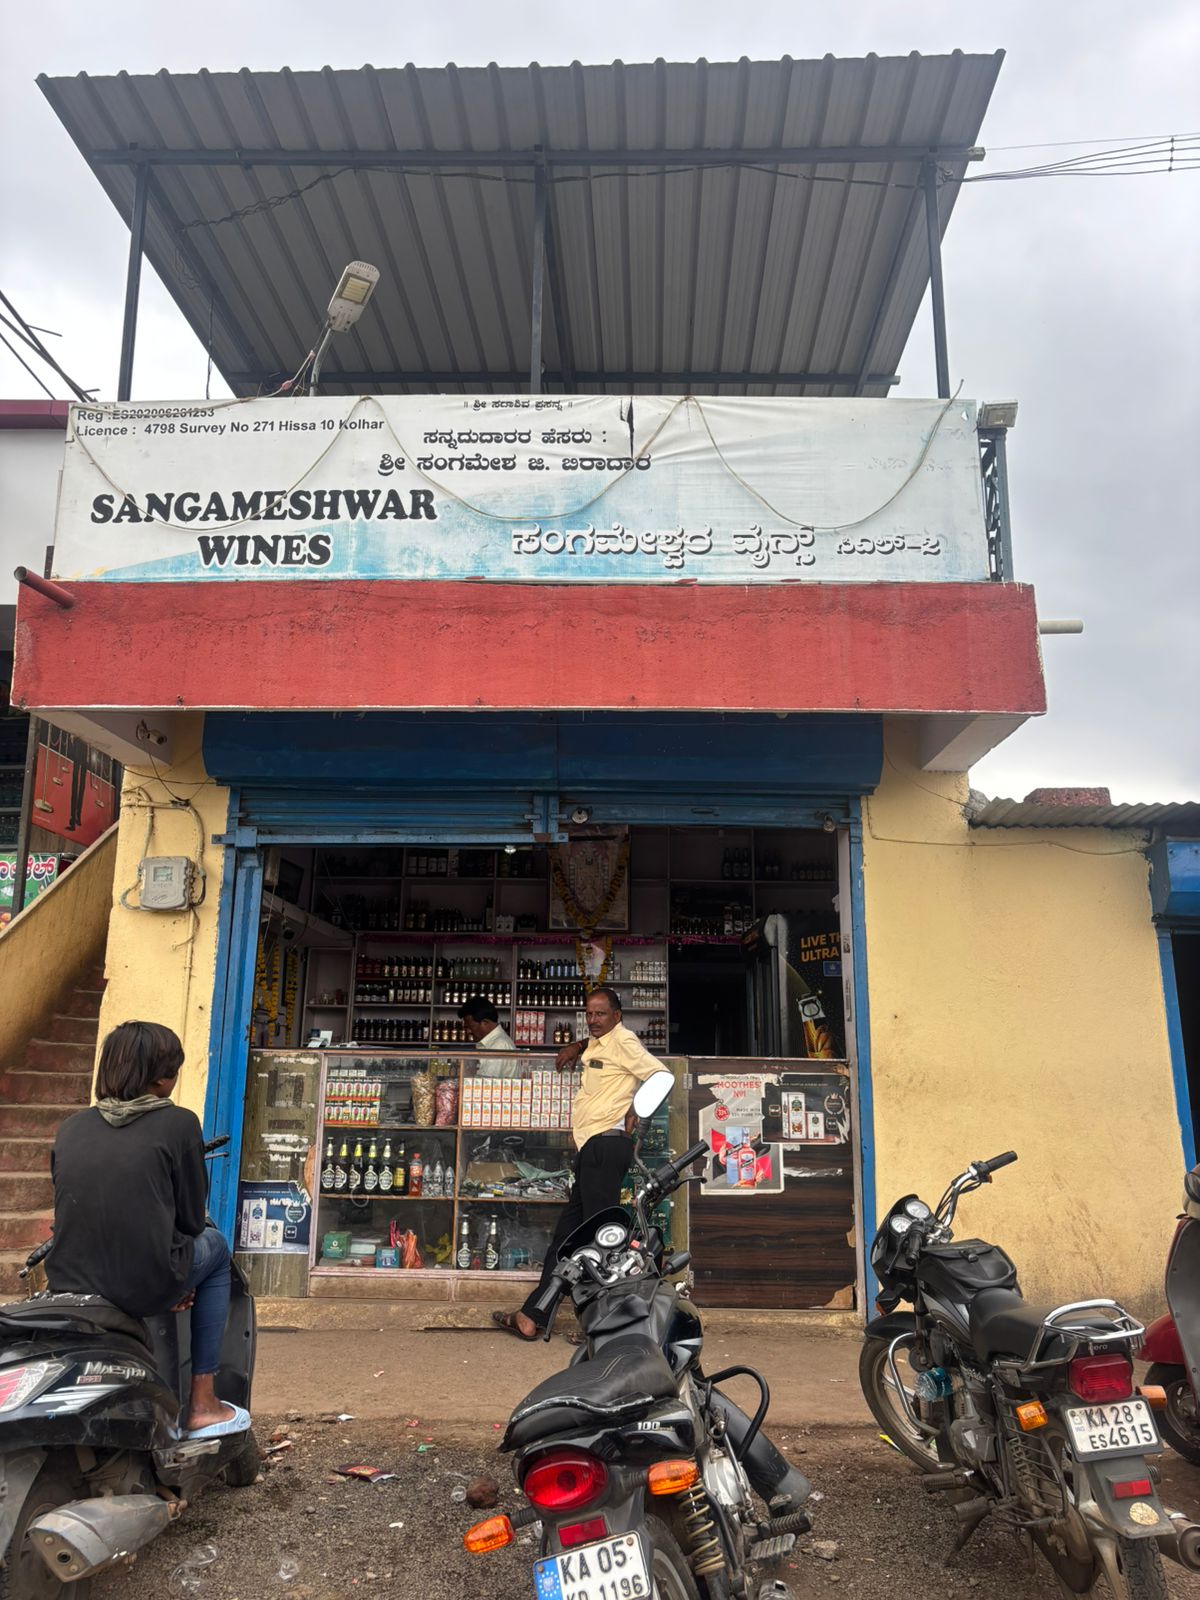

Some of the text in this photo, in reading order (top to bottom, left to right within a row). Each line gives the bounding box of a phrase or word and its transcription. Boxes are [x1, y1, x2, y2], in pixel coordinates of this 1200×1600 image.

[76, 425, 128, 437] Licence
[144, 424, 176, 435] 4798
[179, 422, 226, 437] Survey
[230, 422, 249, 433] No
[253, 421, 275, 432] 271
[279, 420, 317, 432] Hissa
[320, 419, 335, 430] 10
[339, 418, 385, 431] Kolhar
[77, 410, 103, 423] Reg
[541, 428, 592, 444] ಹೆಸರು
[377, 454, 406, 477] ಶ್ರೀ
[416, 453, 517, 472] ಸಂಗಮೇಶ
[90, 488, 438, 524] SANGAMESHWAR
[197, 533, 332, 567] WINES
[511, 521, 714, 569] ಸಂಗಮೇಶ್ವರ
[732, 523, 816, 568] ವೈನ್ಸ್
[800, 934, 827, 949] LIVE
[801, 945, 840, 963] ULTRA
[713, 1080, 762, 1089] MOOTHES
[1084, 1405, 1134, 1428] KA 28
[1088, 1423, 1153, 1450] ES4615
[560, 1540, 627, 1585] KA 05
[600, 1574, 644, 1600] 1196
